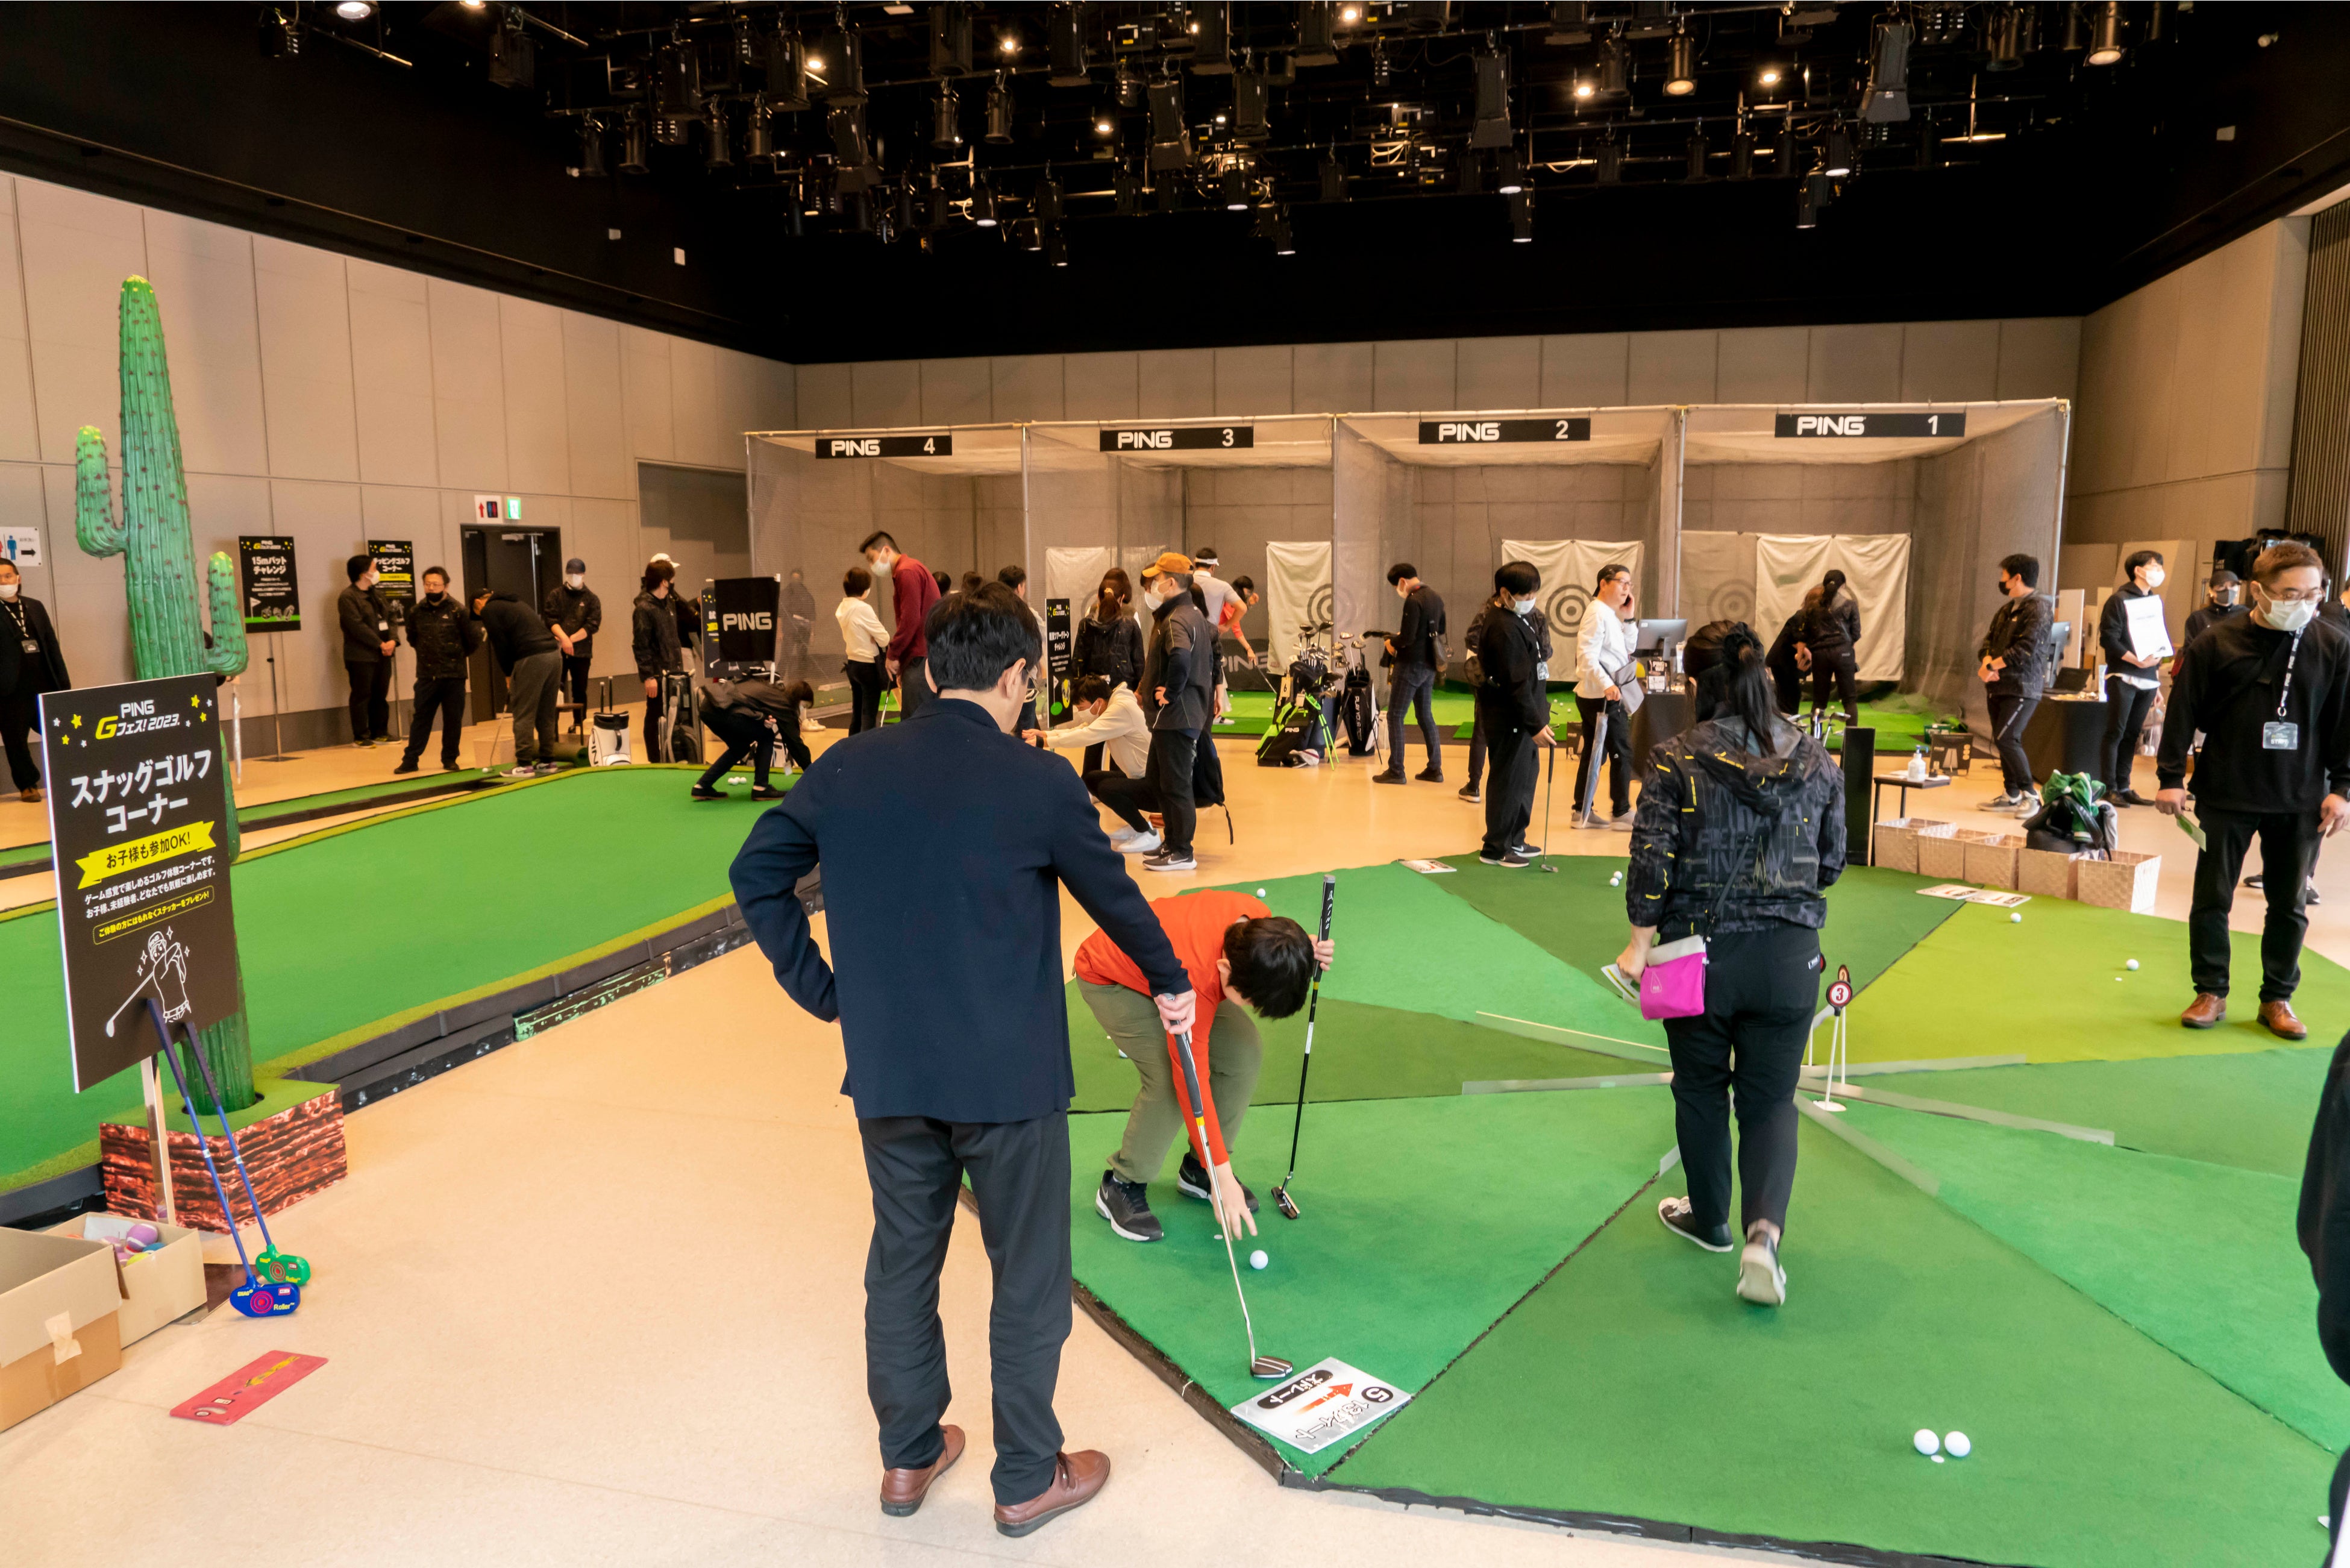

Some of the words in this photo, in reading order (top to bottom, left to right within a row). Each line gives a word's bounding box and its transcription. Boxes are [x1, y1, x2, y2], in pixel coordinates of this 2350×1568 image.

[1439, 422, 1500, 442] PING
[1556, 420, 1568, 439] 2
[1797, 416, 1864, 436] PING
[1928, 415, 1938, 435] 1
[831, 439, 880, 456] PING
[924, 437, 935, 454] 4
[1118, 431, 1173, 449] PING
[1222, 428, 1234, 447] 3
[252, 556, 287, 565] 15mパット
[253, 565, 286, 575] チャレンジ
[723, 612, 772, 632] PING
[1283, 684, 1287, 692] 6
[121, 700, 154, 718] PING
[71, 749, 211, 809] スナッグゴルフ
[106, 793, 189, 833] コーナー
[107, 832, 190, 869] お子様も参加OK!
[1836, 988, 1844, 1001] 3
[1270, 1373, 1323, 1404] ストレート
[1366, 1388, 1390, 1402] 5
